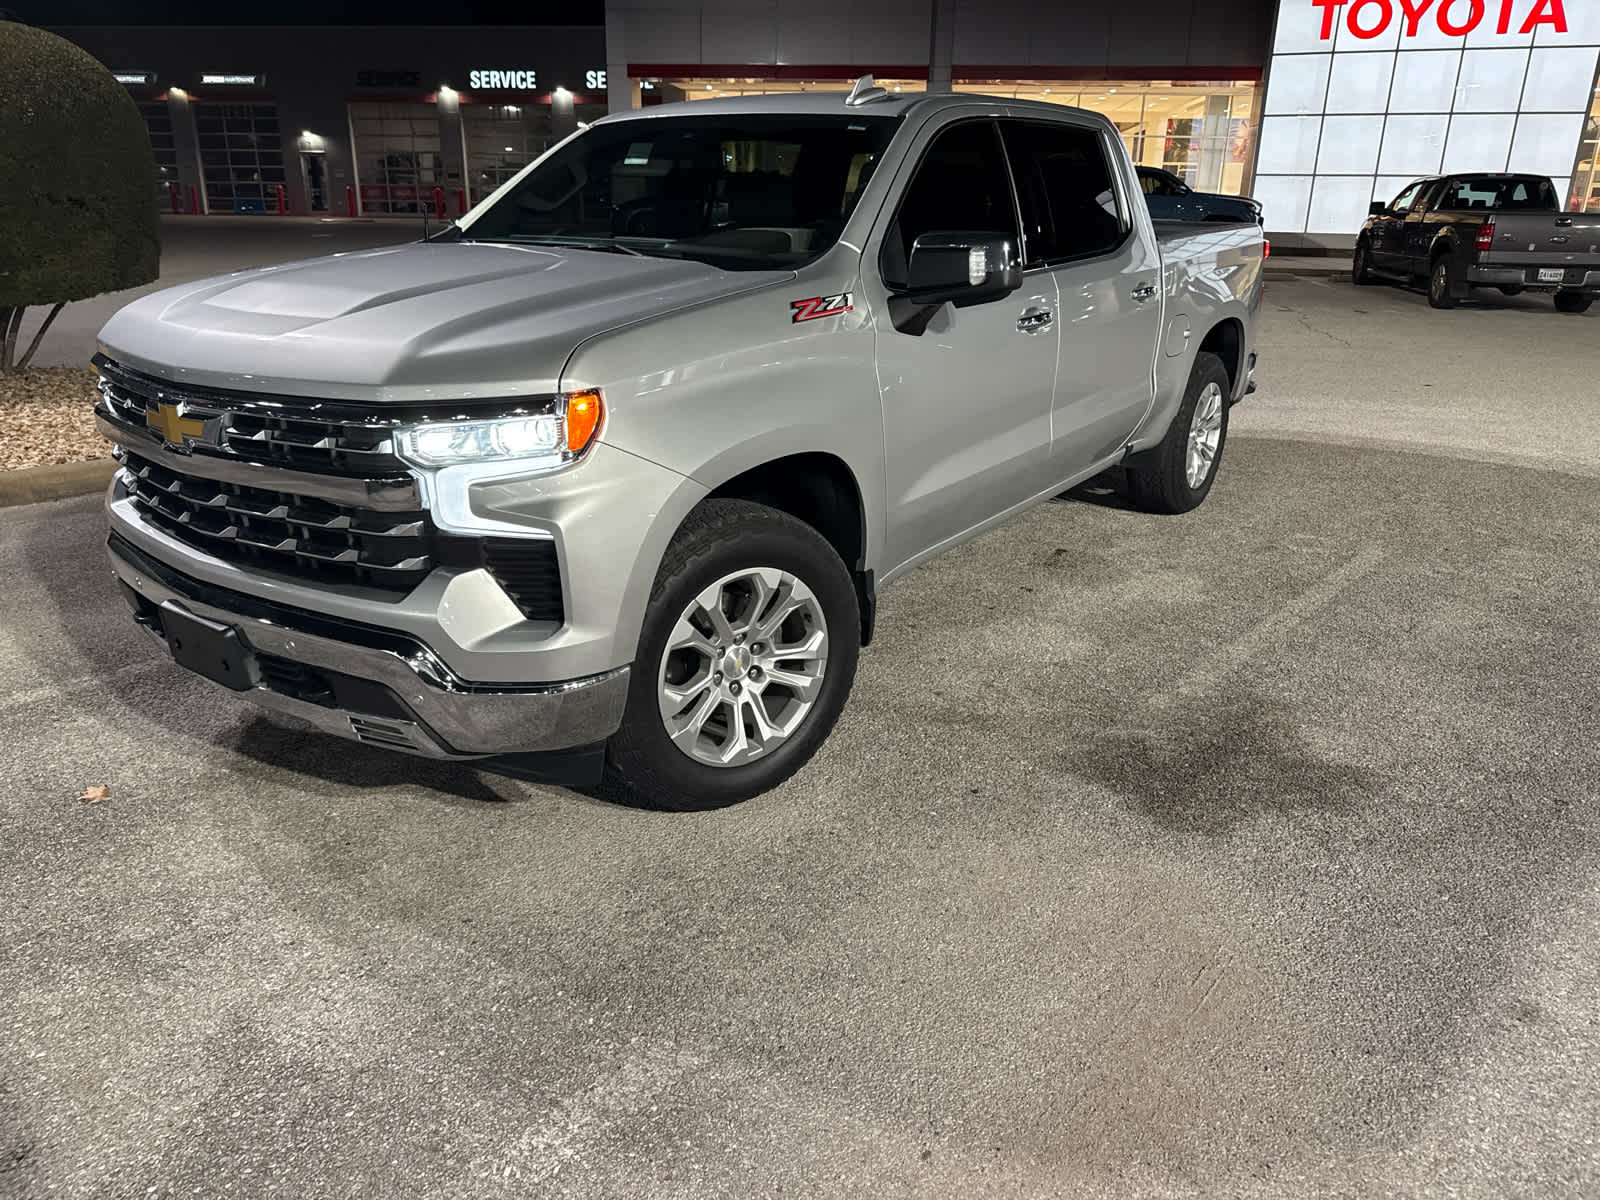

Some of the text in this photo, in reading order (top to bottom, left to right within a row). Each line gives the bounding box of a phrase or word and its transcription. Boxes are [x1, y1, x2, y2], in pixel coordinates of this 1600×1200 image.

[1312, 0, 1568, 41] TOYOTA
[469, 70, 537, 89] SERVICE
[791, 292, 853, 323] Z71
